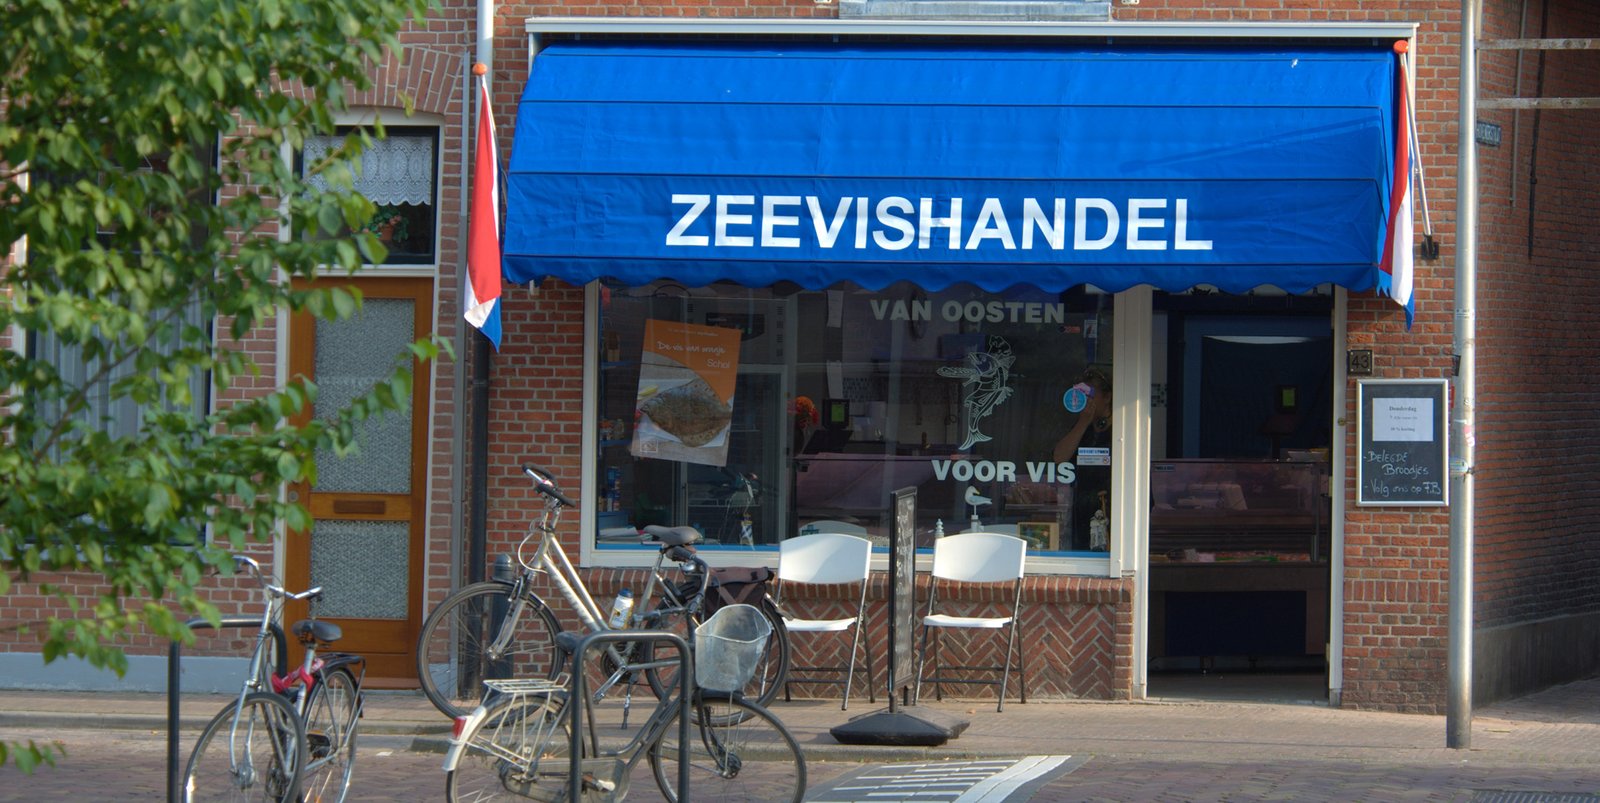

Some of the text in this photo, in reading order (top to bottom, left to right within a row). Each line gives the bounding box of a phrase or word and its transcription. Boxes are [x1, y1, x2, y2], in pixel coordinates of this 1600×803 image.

[665, 193, 1214, 251] ZEEVISHANDEL
[870, 300, 1065, 324] VAN OOSTEN
[706, 359, 731, 369] Schol
[1351, 355, 1369, 369] 43
[931, 459, 1076, 484] VOOR VIS
[1381, 463, 1430, 480] Broodjes
[1370, 479, 1389, 497] Volg
[1410, 485, 1422, 495] op
